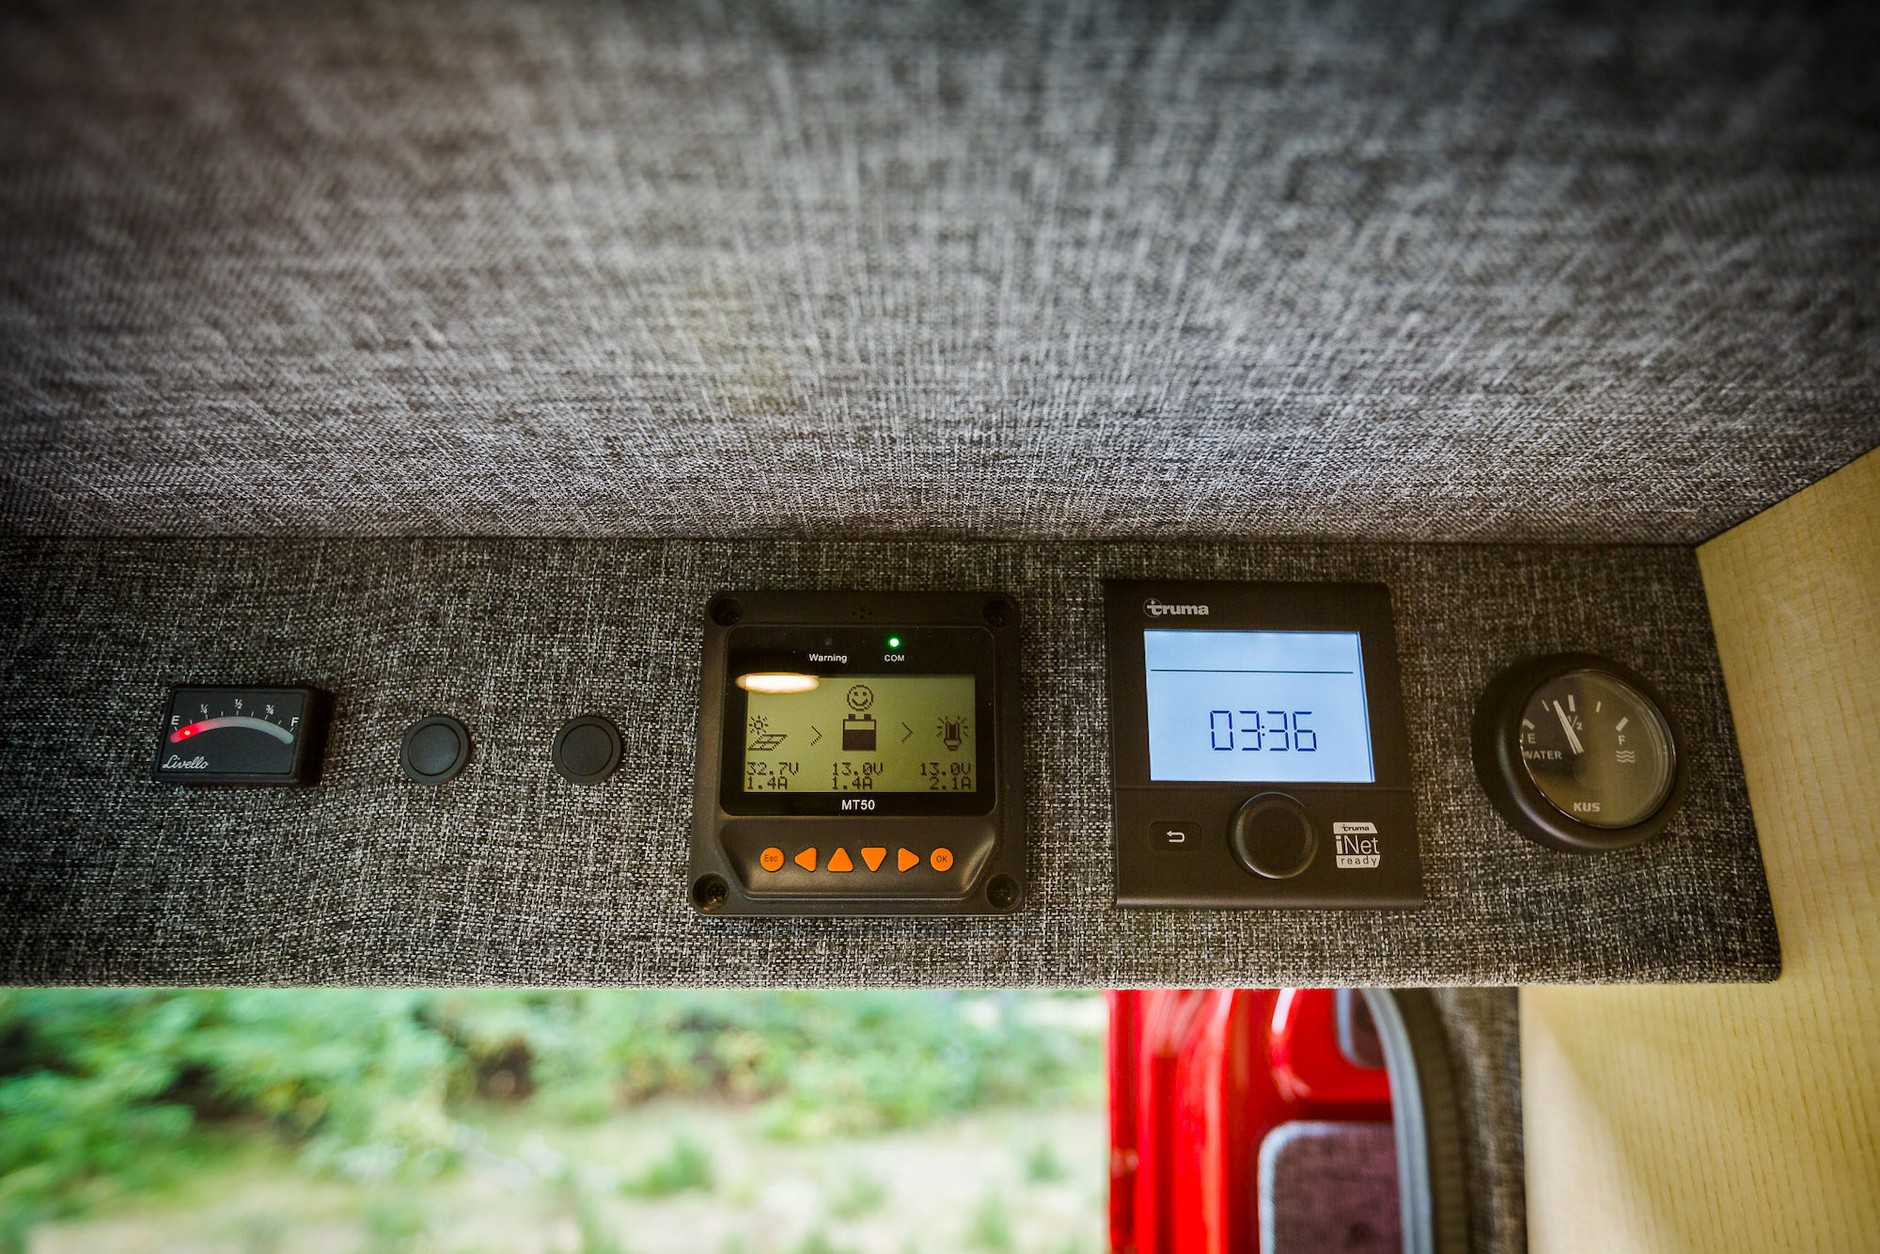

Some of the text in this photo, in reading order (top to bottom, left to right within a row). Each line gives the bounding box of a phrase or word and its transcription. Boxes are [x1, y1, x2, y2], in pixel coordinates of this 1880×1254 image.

[1146, 599, 1210, 616] truma
[808, 653, 848, 664] Warning
[884, 654, 905, 662] COM
[171, 715, 180, 726] E
[291, 717, 299, 727] F
[1209, 709, 1318, 752] 03:36
[1527, 733, 1536, 744] E
[1618, 735, 1626, 745] F
[1523, 750, 1562, 760] WATER
[162, 754, 209, 770] Livello
[746, 762, 799, 776] 32.7V
[832, 762, 884, 777] 13.0V
[920, 763, 972, 777] 13.0V
[747, 776, 788, 790] 1.4A
[832, 776, 873, 790] 1.4A
[929, 776, 972, 790] 2.1A
[841, 799, 876, 811] MT50
[1573, 802, 1601, 812] KUS
[1341, 823, 1370, 832] truma
[1334, 835, 1380, 855] iNet
[764, 855, 779, 863] Esc
[935, 855, 948, 863] OK
[1340, 856, 1378, 868] ready
